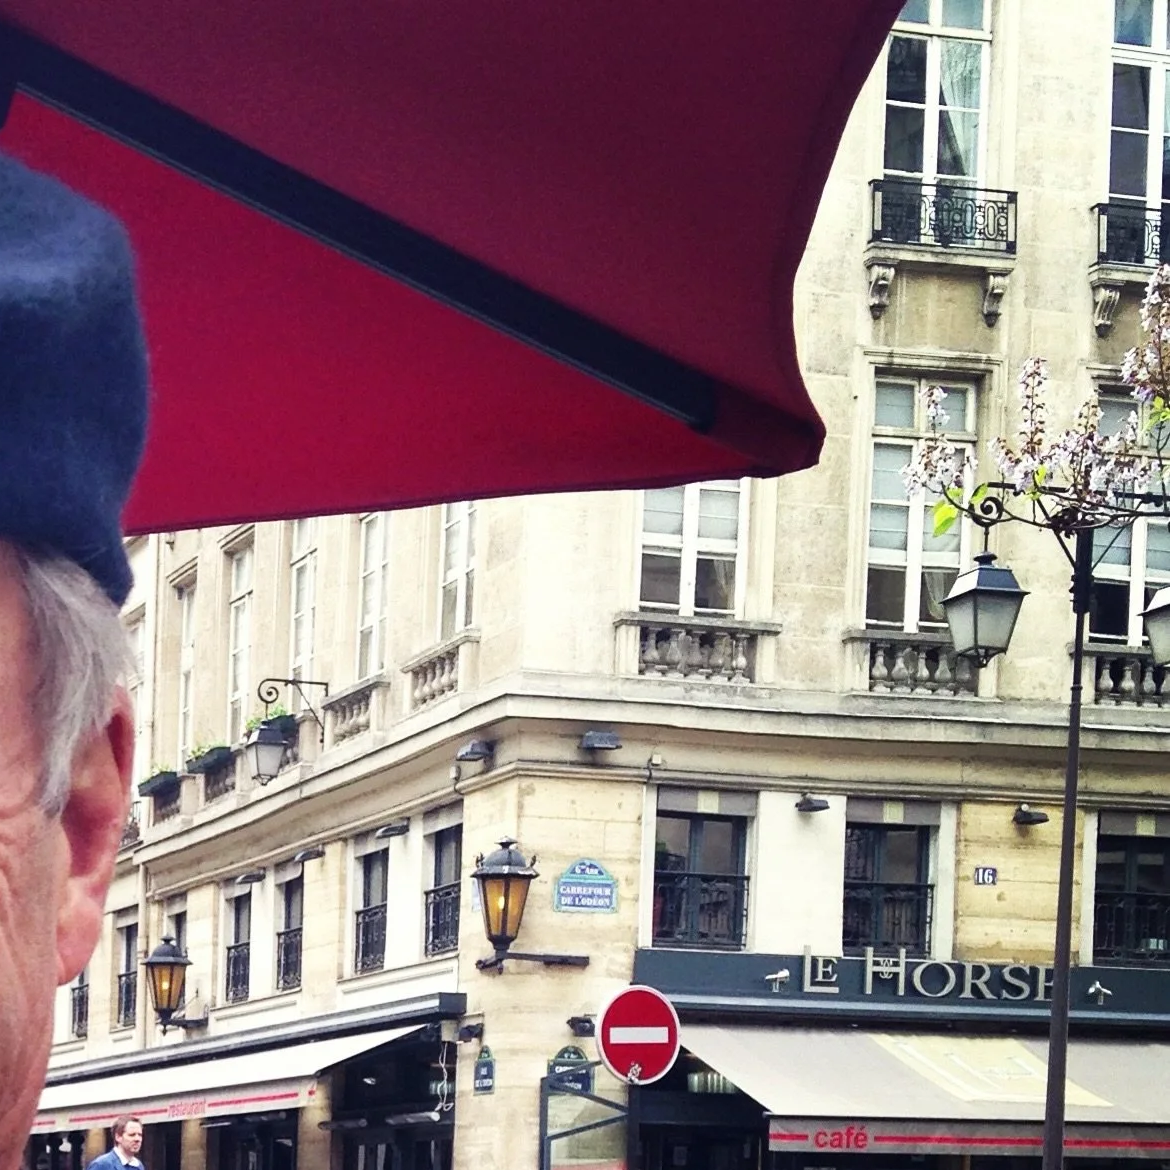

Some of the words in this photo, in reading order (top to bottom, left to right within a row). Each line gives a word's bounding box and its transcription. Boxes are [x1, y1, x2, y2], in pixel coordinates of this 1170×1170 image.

[978, 868, 994, 884] 16
[560, 885, 611, 896] CARREFOUR
[561, 896, 574, 905] DE
[803, 945, 840, 993] LE
[814, 1125, 869, 1149] café
